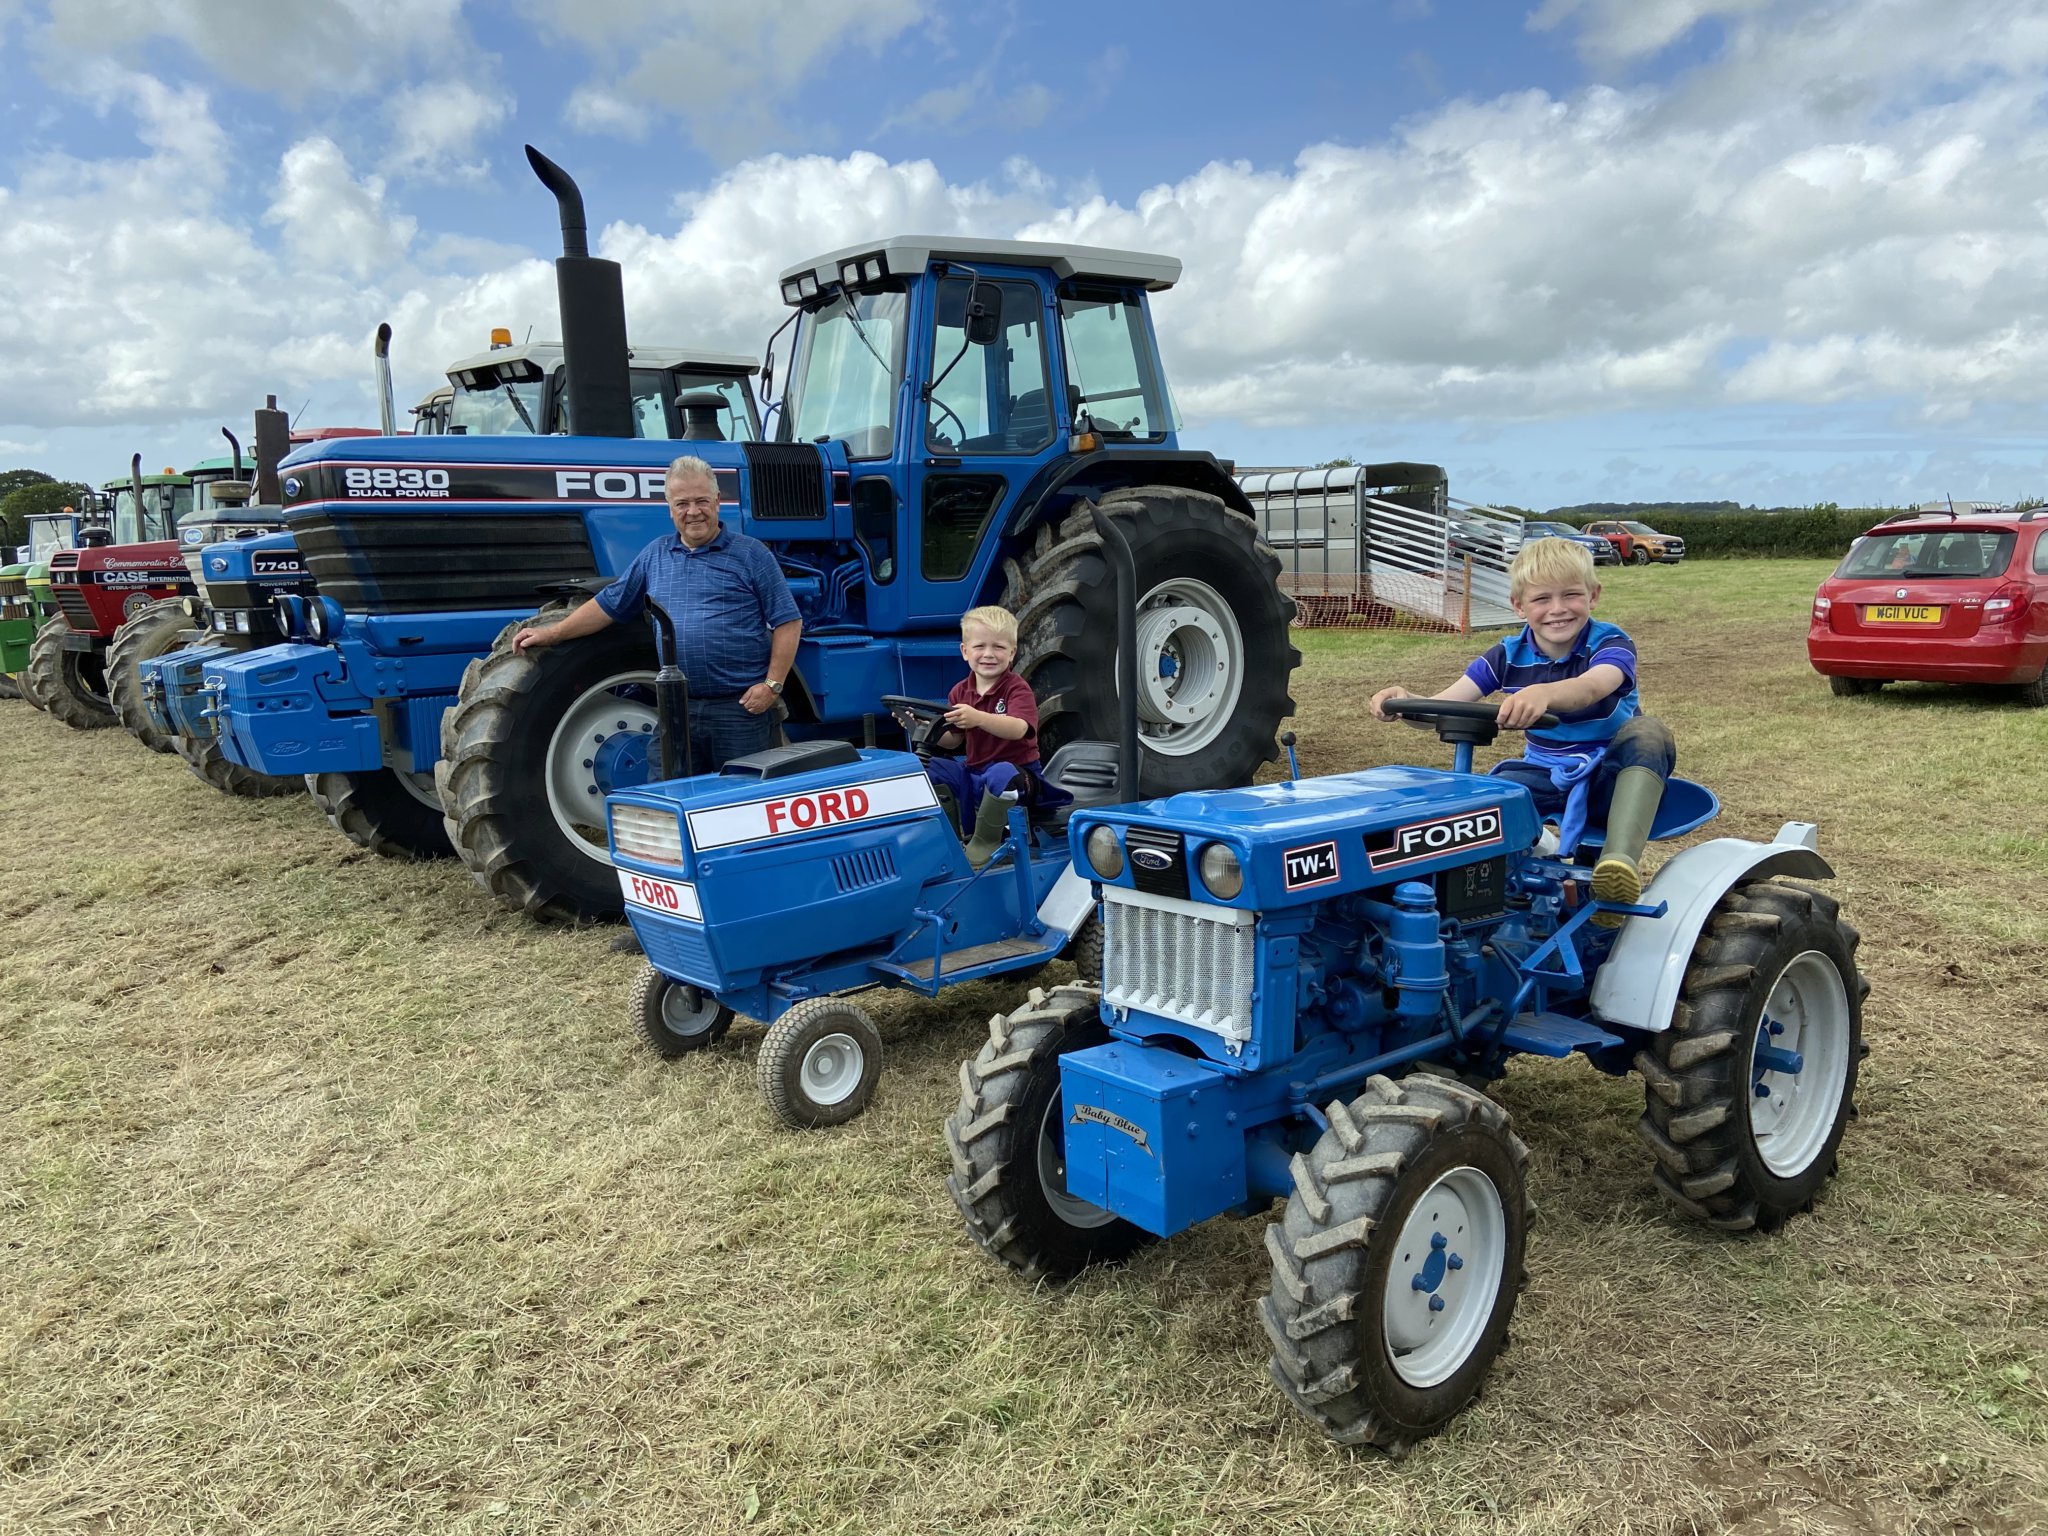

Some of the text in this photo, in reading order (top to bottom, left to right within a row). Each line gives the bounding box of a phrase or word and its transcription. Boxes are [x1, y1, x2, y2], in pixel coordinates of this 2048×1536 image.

[345, 468, 450, 489] 8830
[555, 471, 666, 499] FOR
[348, 489, 450, 498] DUAL POWER
[104, 557, 169, 570] Commemorative
[256, 561, 300, 571] 7740
[103, 571, 149, 583] CASE
[1904, 607, 1929, 619] VUC
[765, 788, 870, 834] FORD
[1402, 815, 1498, 853] FORD
[1139, 853, 1161, 866] Ford
[1287, 851, 1335, 878] TW-1
[631, 876, 679, 910] FORD
[1081, 1105, 1140, 1134] Baby Blue
